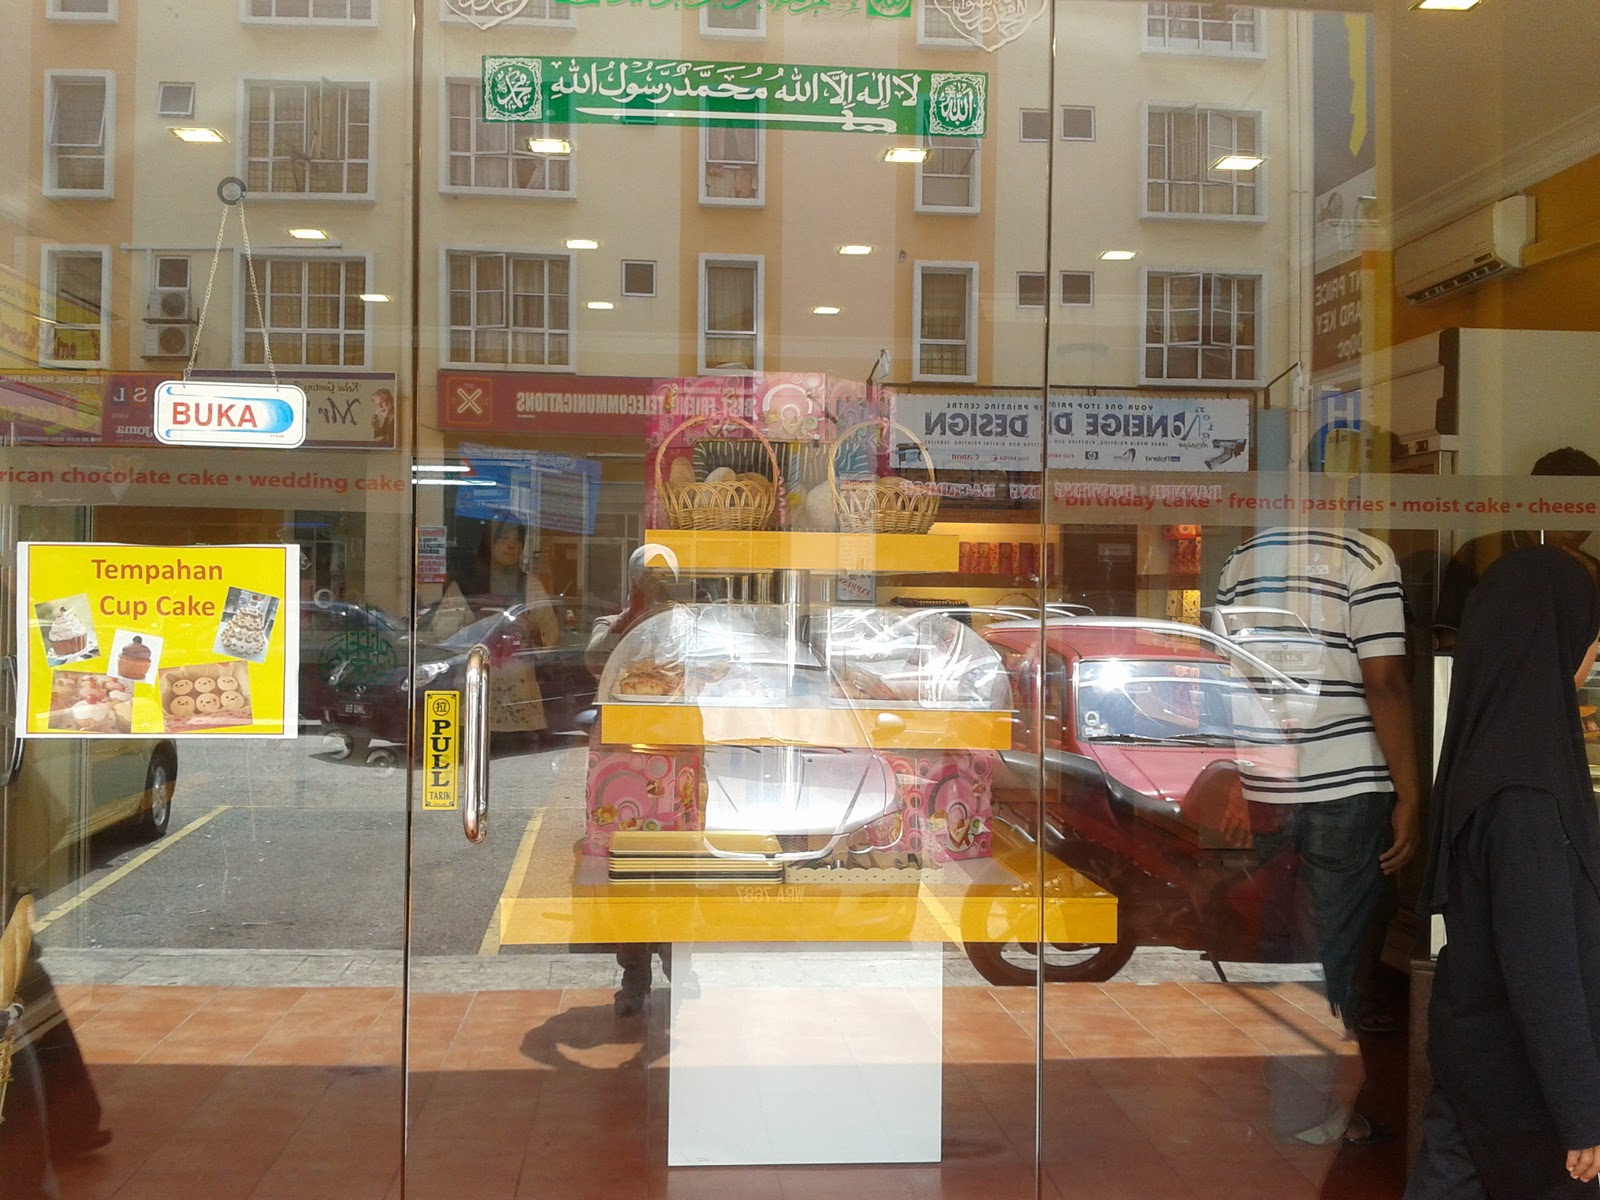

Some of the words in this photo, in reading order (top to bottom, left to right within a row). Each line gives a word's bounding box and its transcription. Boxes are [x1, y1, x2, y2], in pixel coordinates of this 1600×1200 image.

[171, 400, 258, 429] BUKA
[60, 467, 171, 485] chocolate
[176, 468, 229, 487] cake
[249, 472, 349, 494] wedding
[354, 474, 406, 491] cake
[1228, 492, 1297, 511] french
[1301, 495, 1385, 514] pastries
[1402, 497, 1460, 513] moist
[1465, 497, 1511, 513] cake
[1528, 498, 1597, 514] cheese
[91, 558, 223, 584] Tempahan
[99, 595, 148, 620] Cup
[156, 595, 216, 617] Cake
[435, 701, 448, 713] 拉
[430, 719, 452, 787] PULL
[429, 791, 451, 800] TARIK
